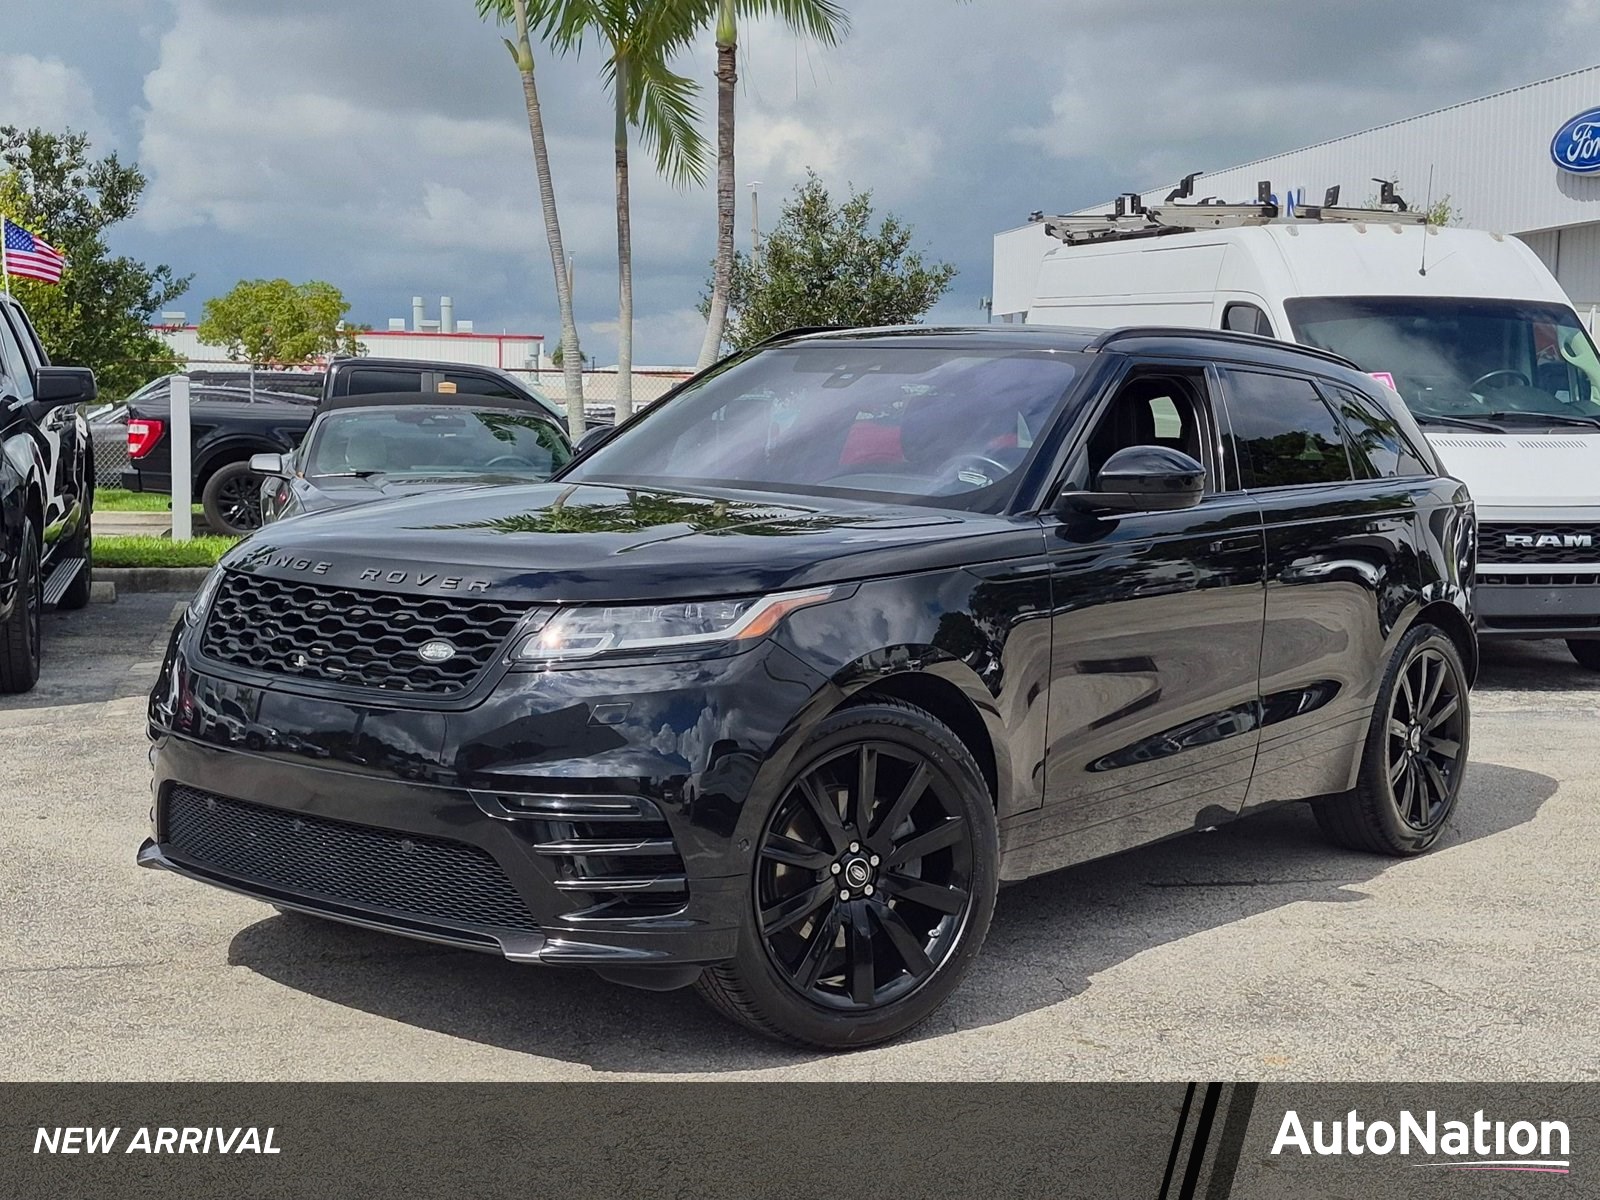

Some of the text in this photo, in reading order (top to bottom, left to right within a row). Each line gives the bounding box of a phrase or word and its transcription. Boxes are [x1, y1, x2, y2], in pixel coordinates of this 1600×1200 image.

[1505, 534, 1592, 547] RAM
[245, 552, 491, 593] RANGE ROVER
